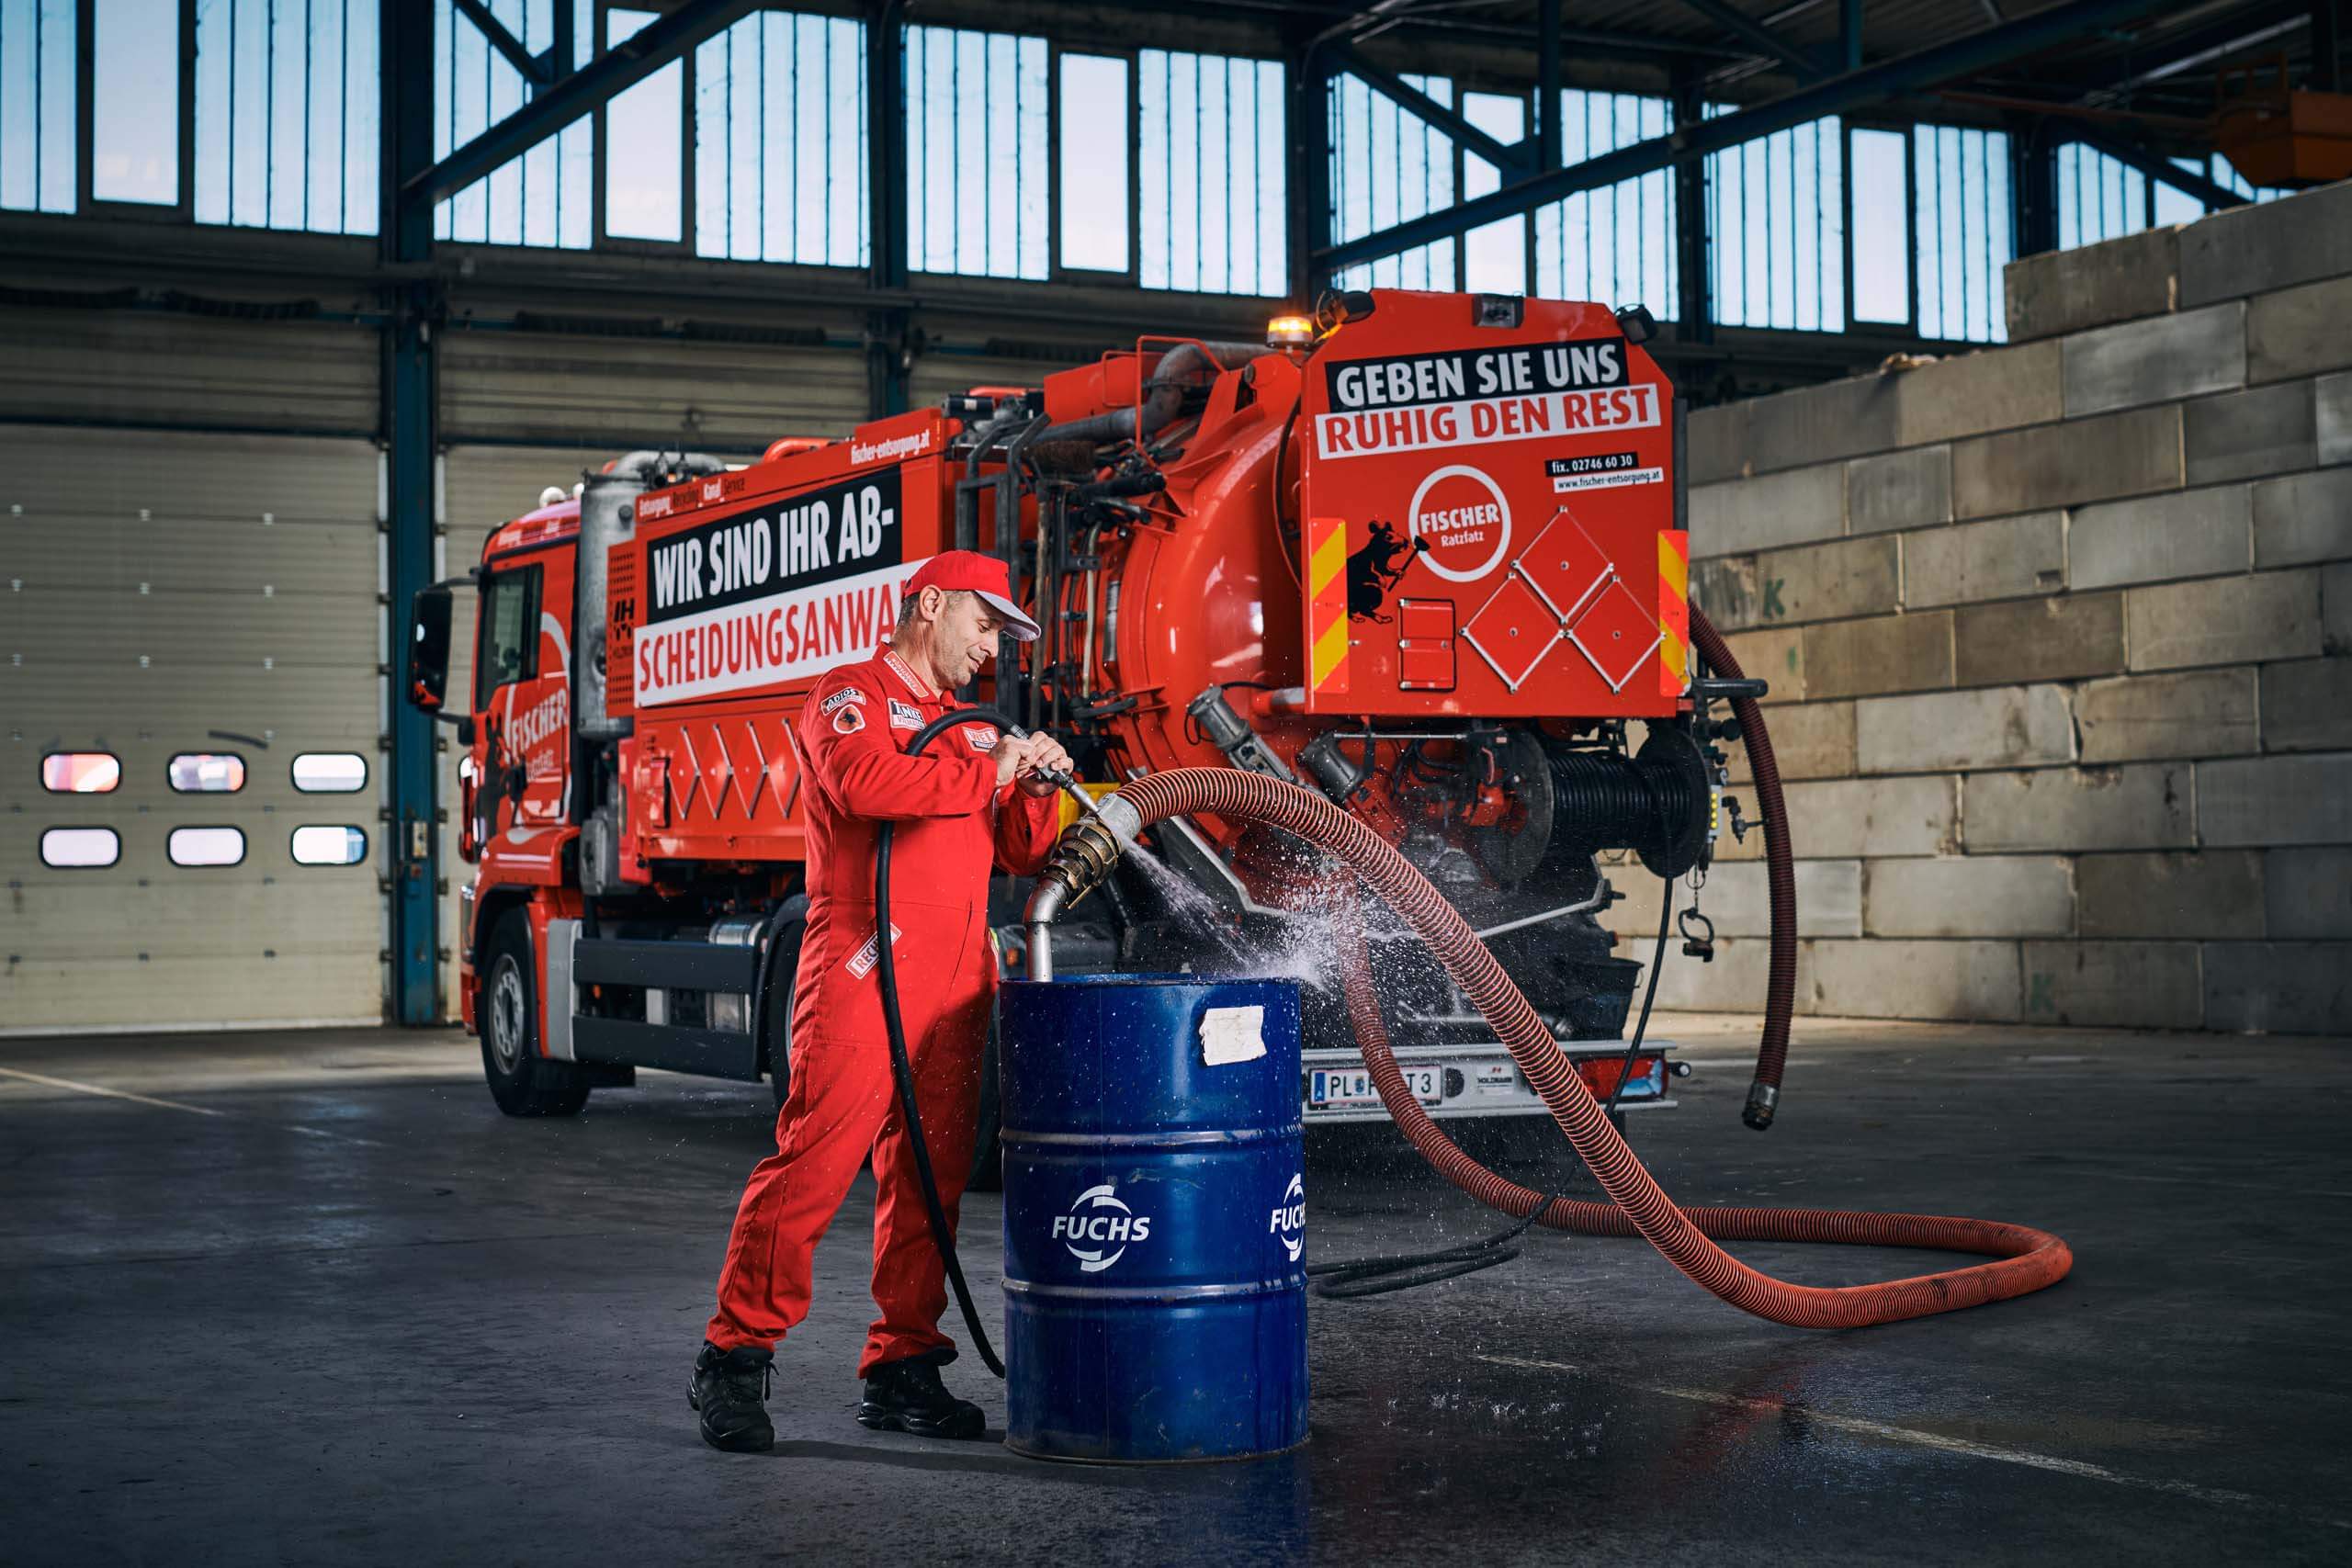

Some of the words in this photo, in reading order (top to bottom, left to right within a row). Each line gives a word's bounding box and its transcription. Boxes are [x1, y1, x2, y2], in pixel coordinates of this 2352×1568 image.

[1337, 357, 1465, 408] GEBEN
[1476, 352, 1534, 395] SIE
[1543, 344, 1620, 388] UNS
[1325, 406, 1458, 454] RUHIG
[1470, 397, 1550, 438] DEN
[1563, 388, 1650, 430] REST
[1551, 460, 1570, 474] fix.
[1572, 457, 1602, 471] 02746
[1605, 456, 1618, 468] 60
[1620, 454, 1634, 467] 30
[1557, 470, 1660, 489] www.fischer-entsorgung.at
[1419, 502, 1499, 534] FISCHER
[653, 537, 704, 609] WIR
[708, 517, 772, 596] SIND
[779, 500, 831, 578] IHR
[837, 485, 894, 563] AB-
[1440, 530, 1485, 547] Ratzfatz
[639, 576, 906, 692] SCHEIDUNGSANWA
[826, 688, 858, 708] ADIOS
[511, 688, 568, 764] FISCHER
[1330, 1076, 1351, 1097] PL
[1052, 1215, 1150, 1241] FUCHS
[1270, 1201, 1306, 1234] FUCH
